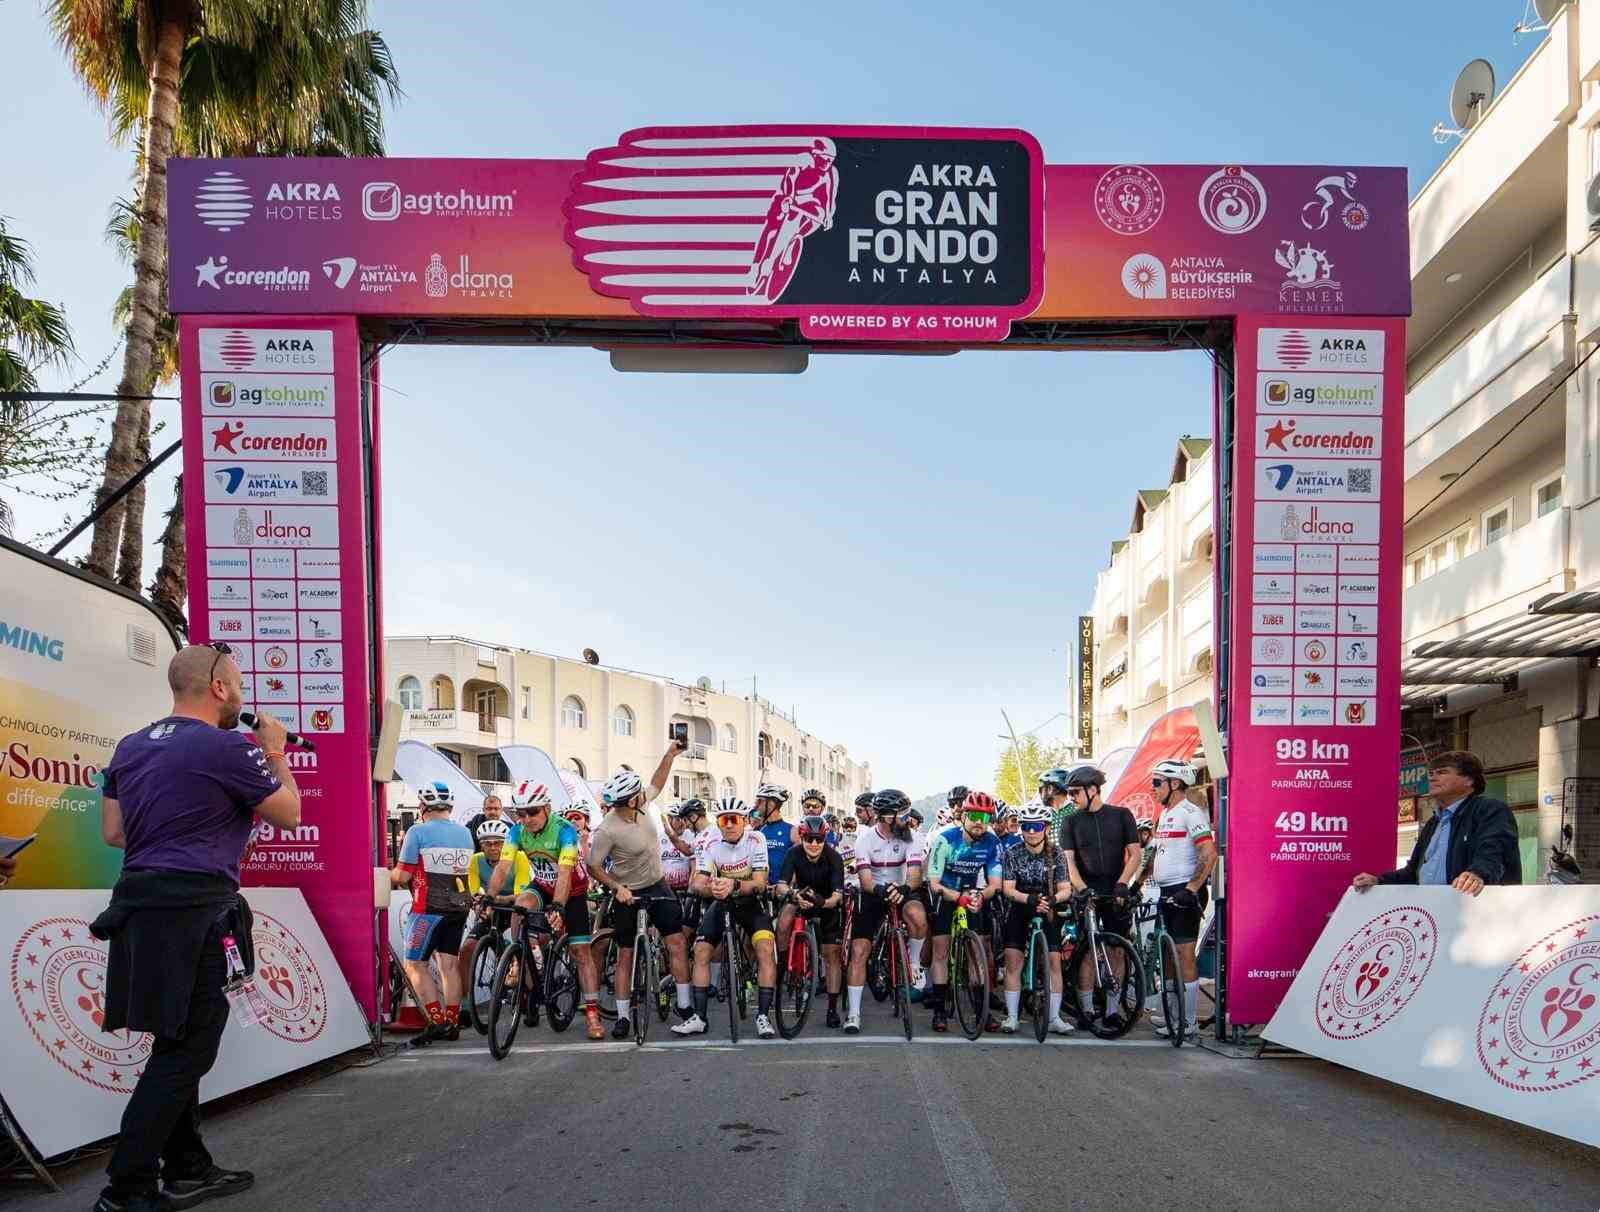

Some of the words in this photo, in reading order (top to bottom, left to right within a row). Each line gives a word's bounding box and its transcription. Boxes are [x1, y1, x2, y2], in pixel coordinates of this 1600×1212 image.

[907, 164, 996, 186] AKRA
[266, 182, 341, 201] AKRA
[403, 189, 513, 215] agtohum
[874, 190, 997, 225] GRAN
[265, 206, 343, 221] HOTELS
[848, 228, 997, 264] FONDO
[1170, 257, 1225, 268] ANTALYA
[224, 266, 310, 286] corendon
[359, 271, 417, 282] ANTALYA
[450, 255, 513, 289] diana
[848, 268, 997, 283] ANTALYA
[1170, 268, 1252, 286] BÜYÜKŞEHİR
[359, 282, 393, 293] Airport
[1171, 285, 1236, 299] BELEDİYESİ
[1279, 290, 1344, 302] KEMER
[810, 315, 887, 328] POWERED
[891, 316, 912, 328] BY
[916, 316, 938, 328] AG
[942, 316, 997, 329] TOHUM
[265, 339, 314, 351] AKRA
[1320, 338, 1366, 350] AKRA
[264, 353, 316, 365] HOTELS
[1319, 352, 1367, 363] HOTELS
[240, 385, 325, 405] agtohum
[1294, 385, 1374, 403] agtohum
[241, 433, 328, 451] corendon
[1292, 431, 1374, 449] corendon
[247, 479, 298, 489] ANTALYA
[1296, 477, 1344, 486] ANTALYA
[248, 490, 277, 498] Airport
[1296, 487, 1323, 495] Airport
[256, 510, 311, 538] diana
[1301, 506, 1354, 534] diana
[1082, 620, 1091, 655] VOIS
[1082, 661, 1092, 705] KEMER
[68, 730, 116, 750] PARTNER
[1082, 711, 1092, 755] HOTEL
[1275, 738, 1306, 760] 98
[1311, 738, 1349, 760] km
[1295, 769, 1330, 780] AKRA
[1271, 780, 1312, 789] PARKURU
[1318, 780, 1353, 789] COURSE
[1274, 811, 1306, 832] 49
[1310, 811, 1349, 832] km
[1279, 842, 1300, 852] AG
[1302, 842, 1343, 852] TOHUM
[249, 851, 267, 862] AG
[268, 851, 315, 862] TOHUM
[1270, 852, 1311, 861] PARKURU
[1317, 852, 1352, 861] COURSE
[240, 862, 282, 871] PARKURU
[289, 862, 325, 871] COURSE
[720, 859, 748, 872] Asperox
